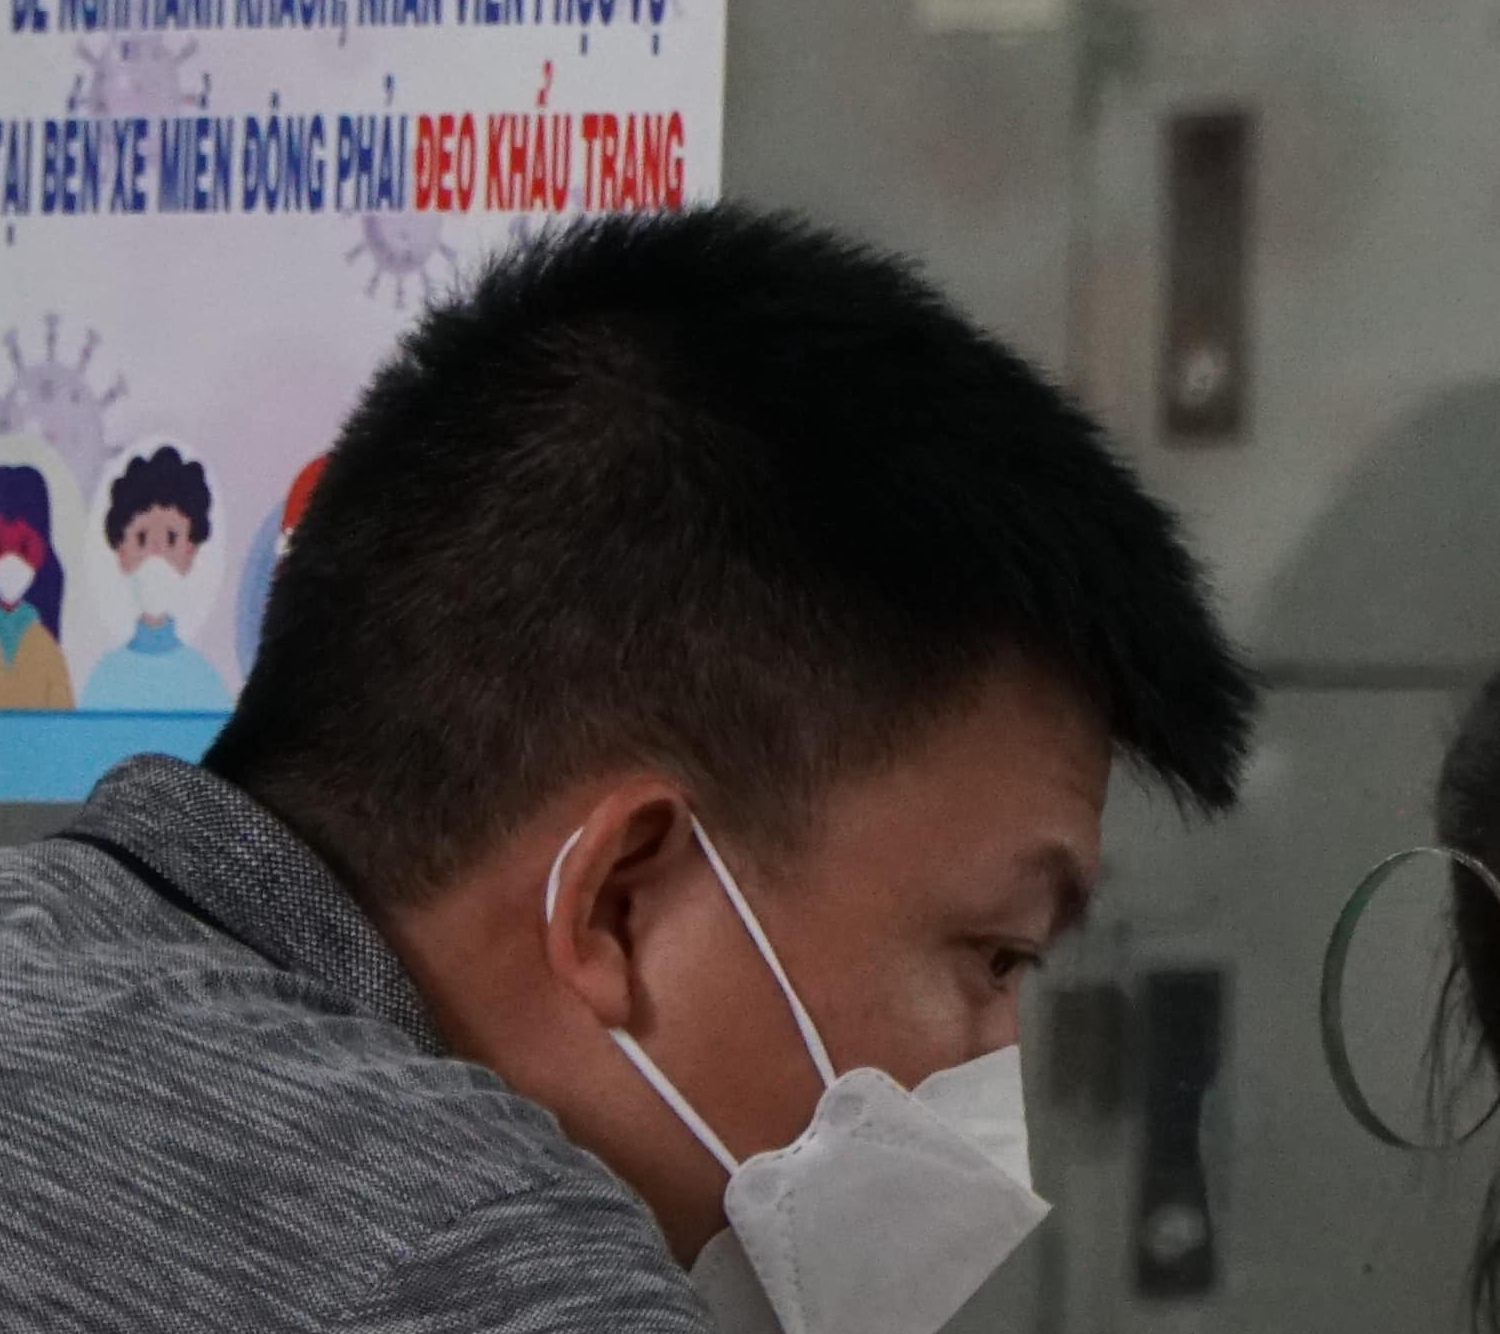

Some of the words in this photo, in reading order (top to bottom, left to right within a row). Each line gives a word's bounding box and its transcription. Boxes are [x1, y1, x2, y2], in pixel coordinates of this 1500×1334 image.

[42, 73, 100, 216] BẾN
[110, 119, 147, 216] XE
[242, 91, 328, 216] ĐÔNG
[336, 73, 408, 216] PHẢI
[415, 114, 477, 213] ĐEO
[486, 61, 570, 213] KHẨU
[582, 111, 685, 213] TRANG
